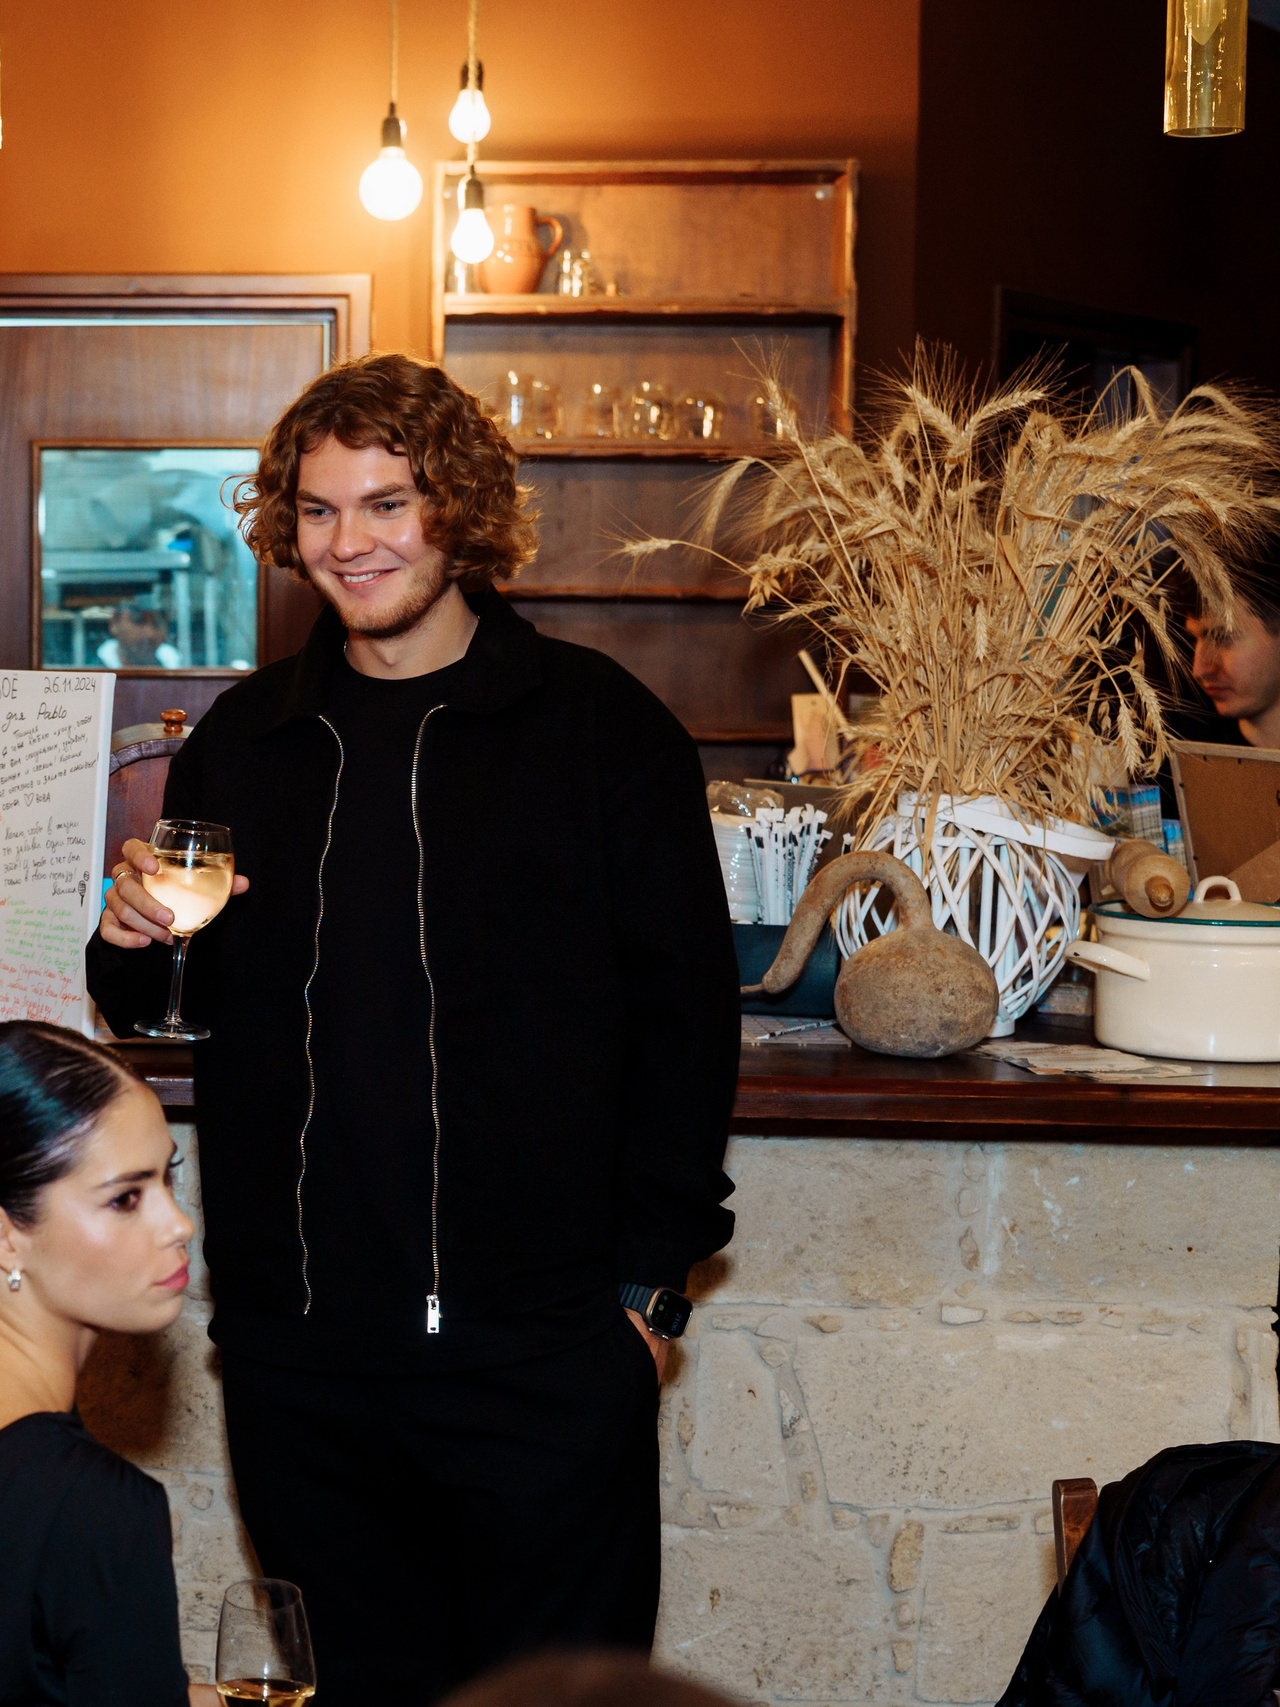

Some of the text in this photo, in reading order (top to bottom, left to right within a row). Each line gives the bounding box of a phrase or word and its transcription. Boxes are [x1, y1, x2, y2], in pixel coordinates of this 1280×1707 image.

[43, 676, 97, 693] 26.11.2024
[1, 711, 25, 732] для
[36, 701, 68, 720] Pablo
